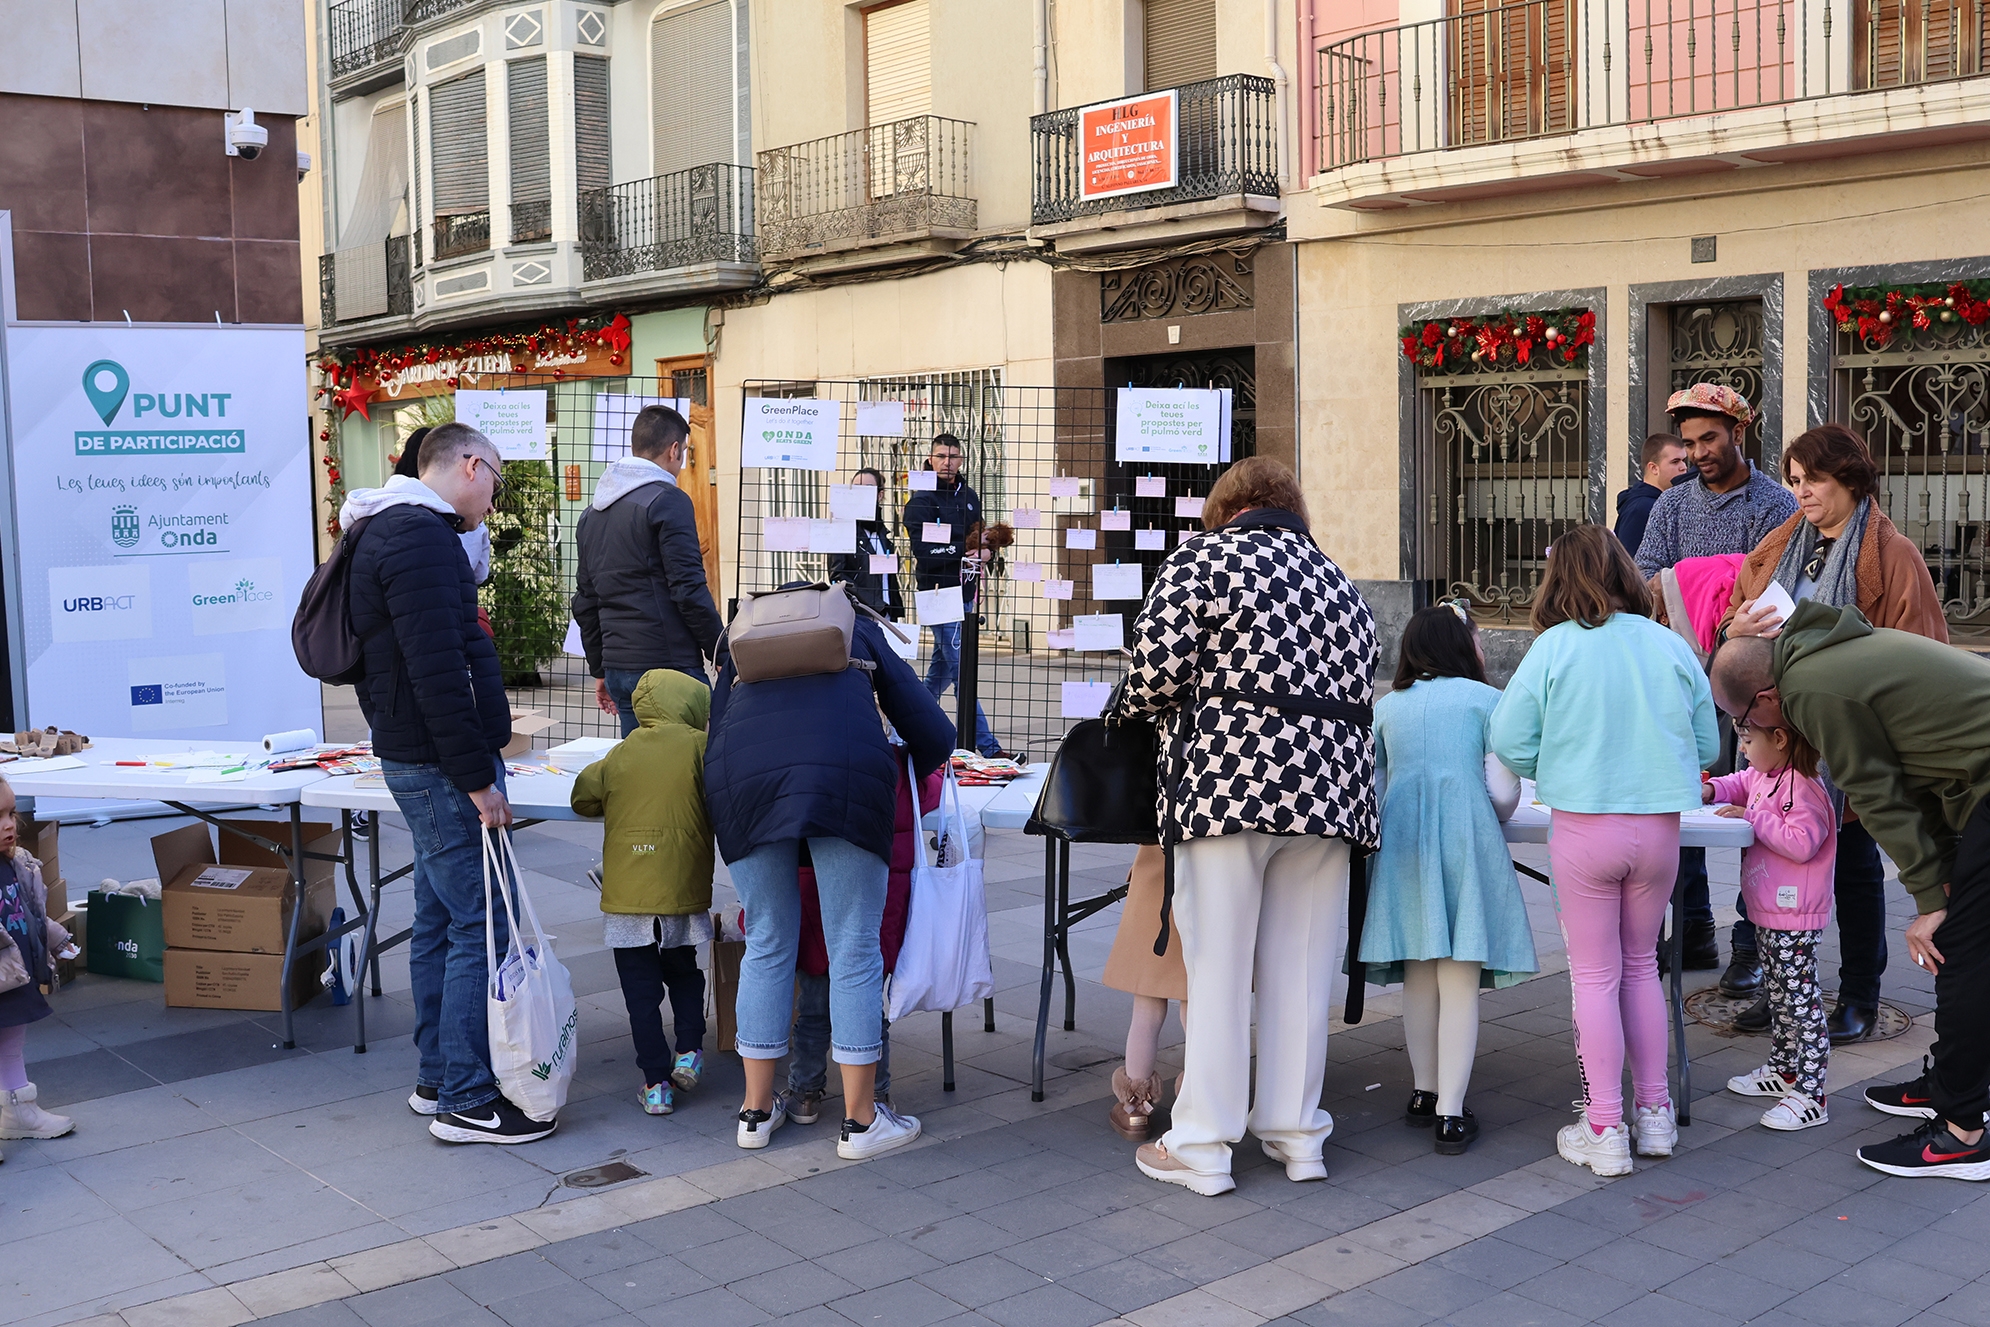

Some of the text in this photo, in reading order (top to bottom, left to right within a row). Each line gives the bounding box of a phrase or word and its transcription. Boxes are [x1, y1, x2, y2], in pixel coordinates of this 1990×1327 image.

[1096, 114, 1155, 136] INGENIERÍA
[1121, 133, 1129, 144] Y
[1088, 140, 1164, 162] ARQUITECTURA
[133, 393, 231, 418] PUNT
[483, 402, 507, 410] Deixa
[1145, 400, 1200, 410] Deixa ací les
[761, 404, 819, 417] GreenPlace
[1160, 410, 1184, 418] teues
[480, 419, 519, 428] propostes
[791, 418, 814, 426] together
[1141, 419, 1185, 430] propostes
[480, 426, 533, 436] al pulmó verd
[776, 431, 812, 439] ONDA
[1140, 427, 1203, 437] al pulmó verd
[78, 431, 241, 450] DE PARTICIPACIÓ
[56, 470, 271, 493] Les teues idees són importants
[148, 512, 229, 530] Ajuntament
[63, 595, 135, 612] URBACT
[164, 682, 197, 690] Co-funded
[176, 688, 206, 696] European
[632, 844, 655, 852] VLTN
